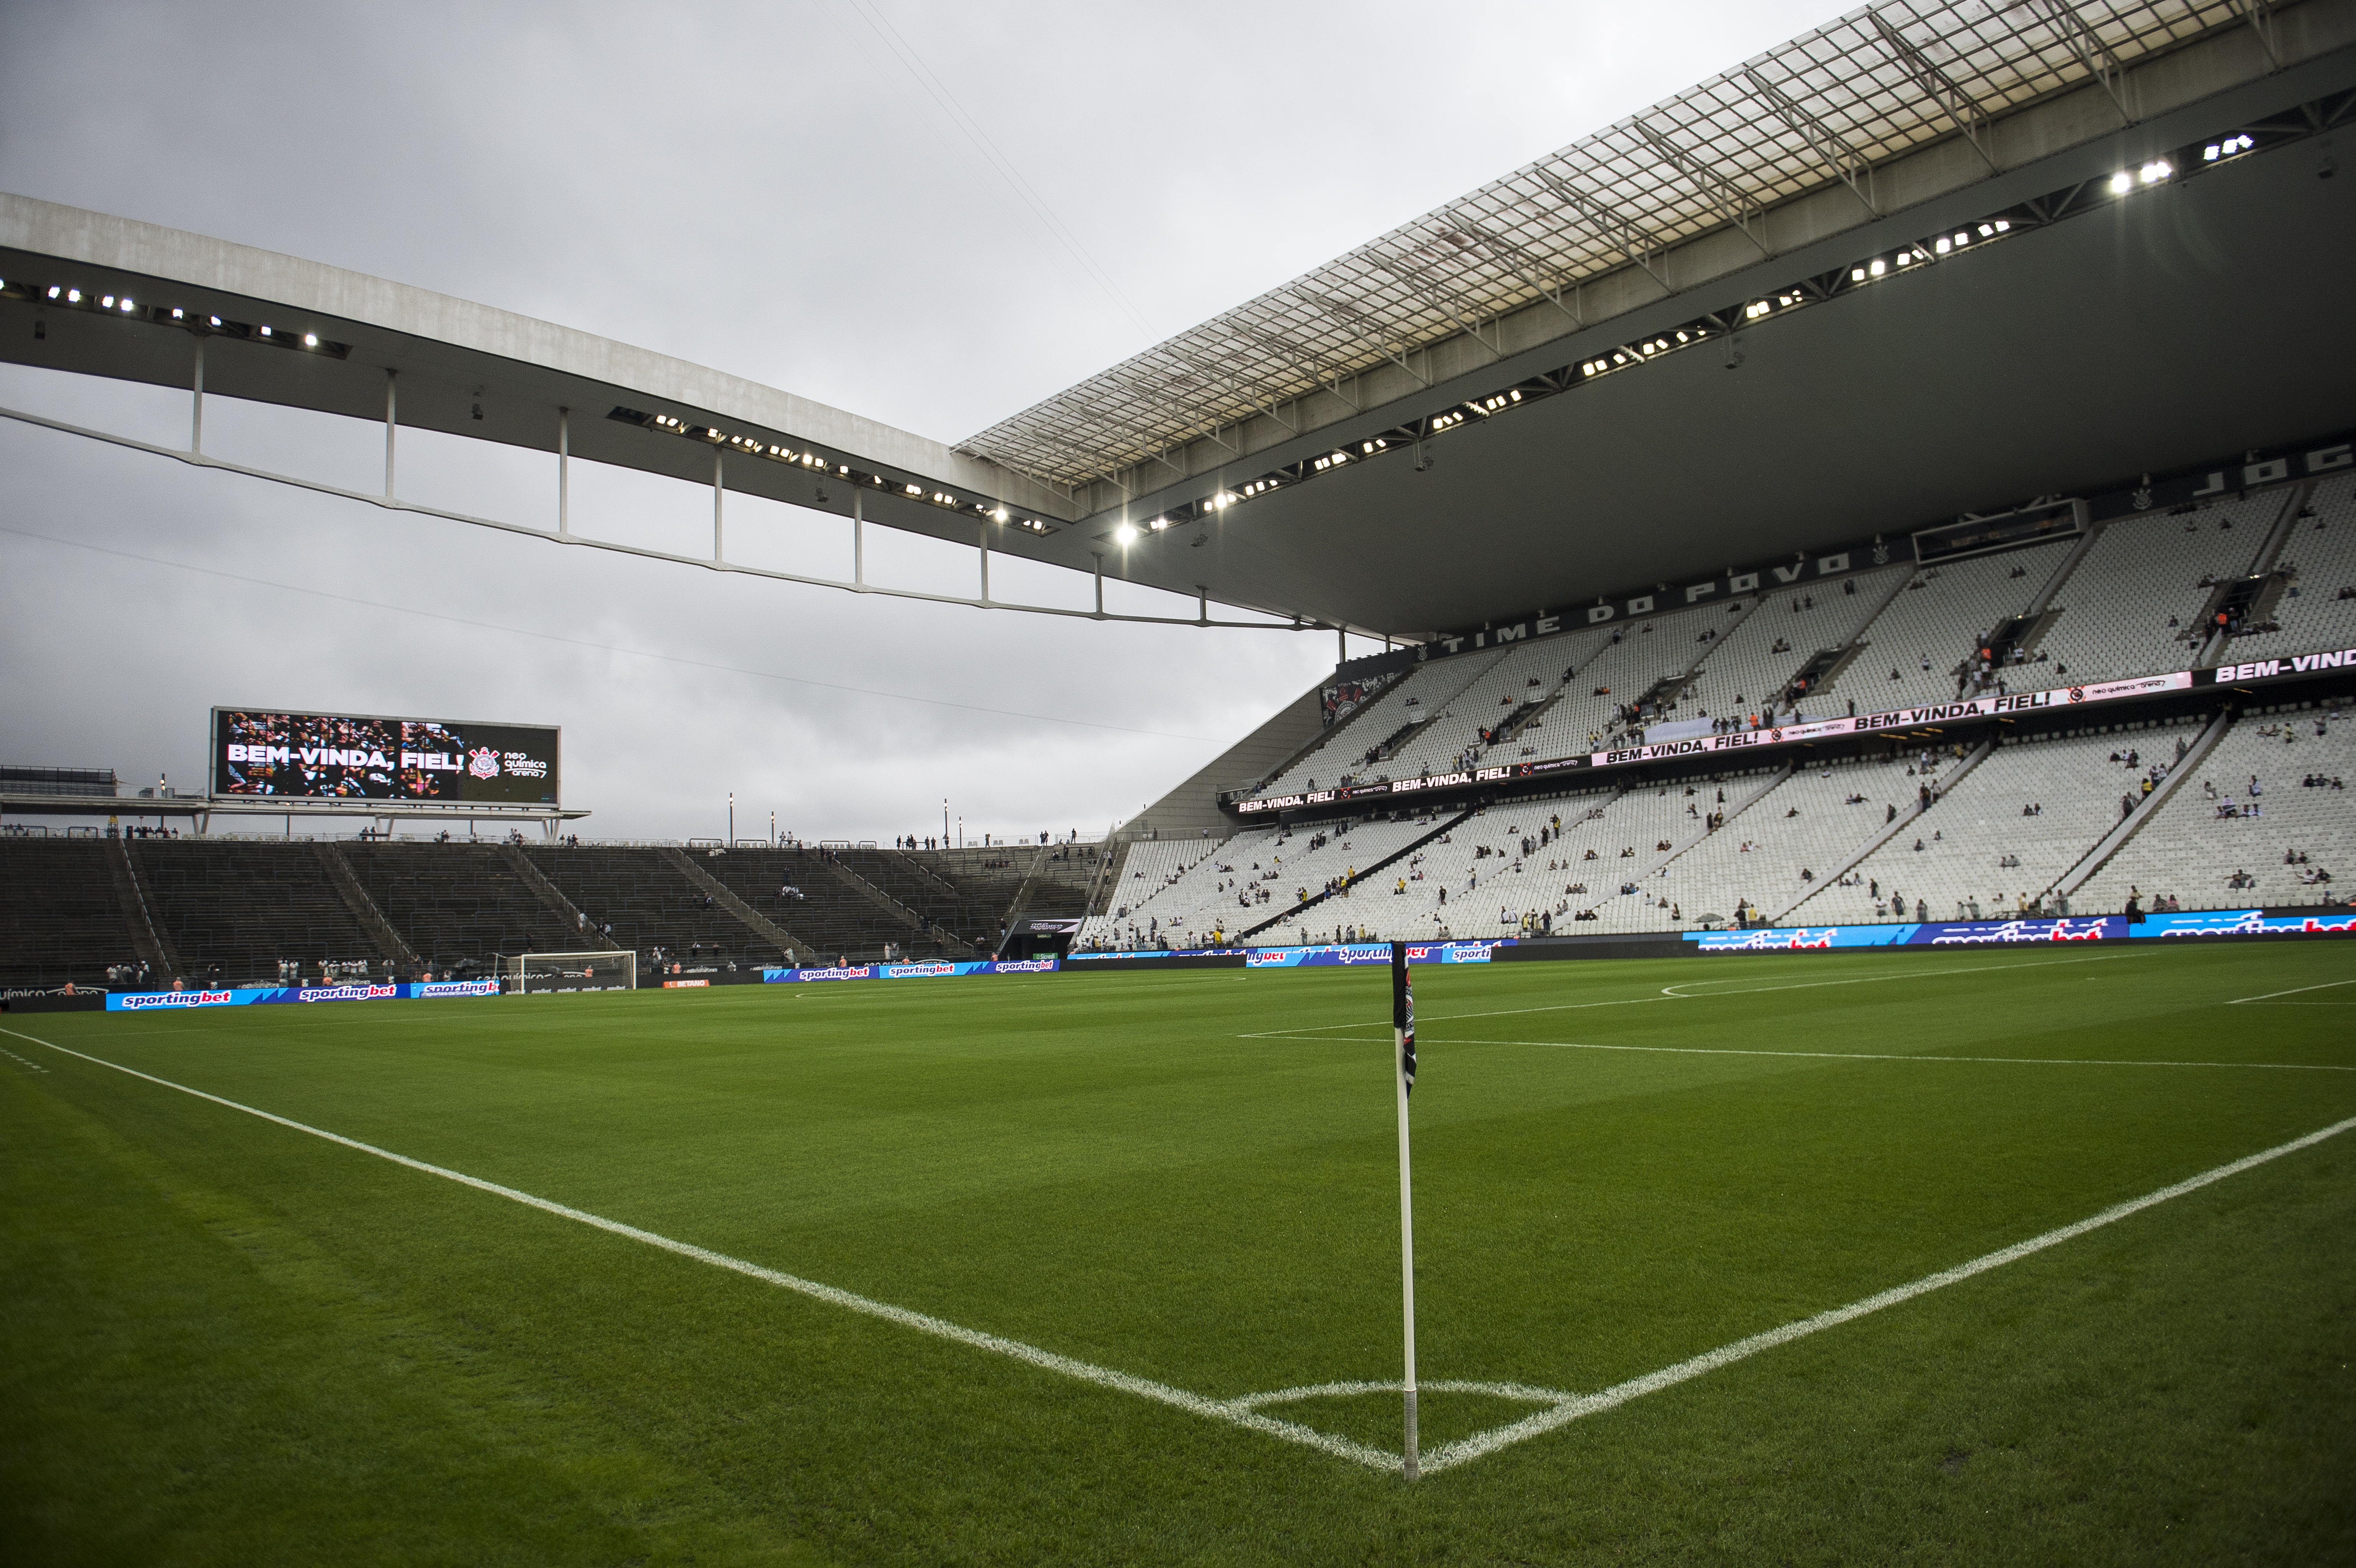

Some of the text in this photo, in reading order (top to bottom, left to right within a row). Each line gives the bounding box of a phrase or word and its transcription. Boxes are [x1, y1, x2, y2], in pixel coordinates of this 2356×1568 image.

[1441, 552, 1850, 653] TIME DO POVO
[1854, 692, 2050, 730] BEM-VINDA, FIEL!
[504, 752, 527, 760] neo
[1606, 732, 1759, 763] BEM-VINDA, FIEL!
[228, 744, 464, 771] BEM-VINDA, FIEL!
[504, 759, 547, 769] química
[1392, 766, 1511, 792] BEM-VINDA, FIEL!
[1238, 790, 1335, 813] BEM-VINDA, FIEL!
[800, 967, 869, 980] sportingbet
[890, 963, 954, 977] sportingbet
[997, 959, 1053, 972] sportingbet
[123, 990, 231, 1008] sportingbet
[301, 984, 396, 1001] sportingbet
